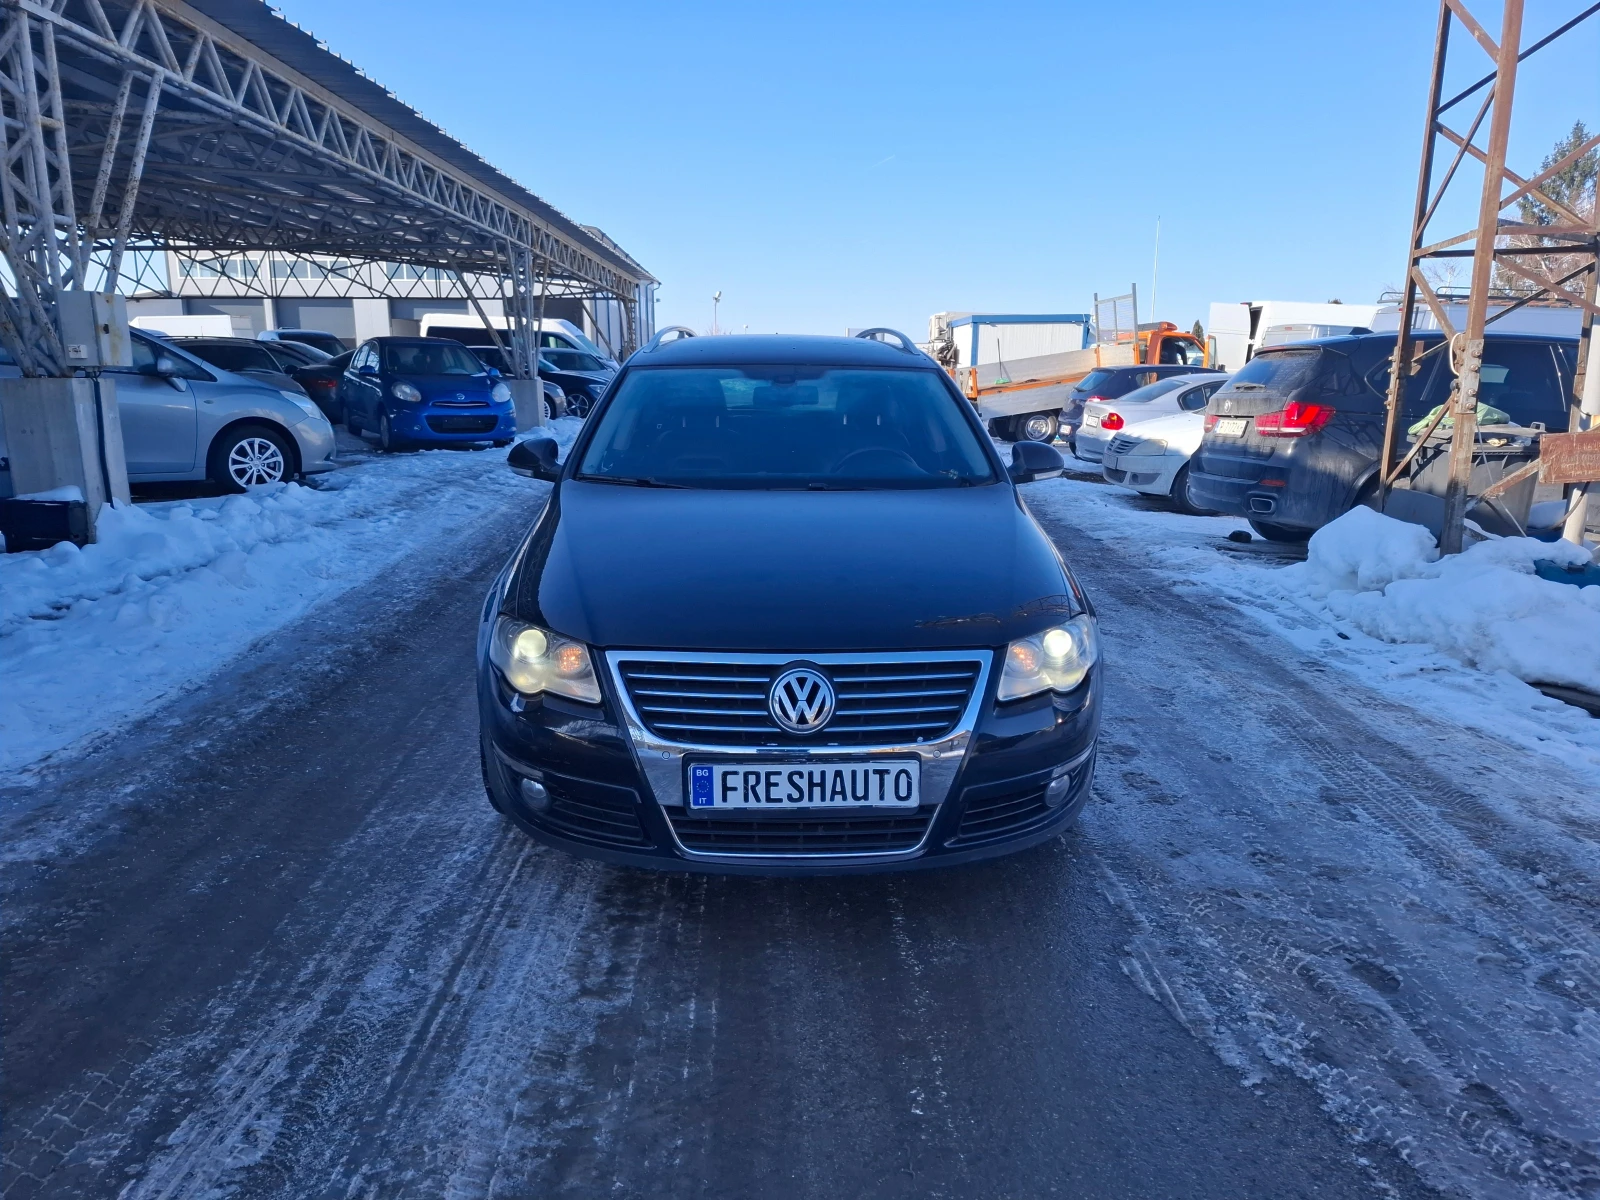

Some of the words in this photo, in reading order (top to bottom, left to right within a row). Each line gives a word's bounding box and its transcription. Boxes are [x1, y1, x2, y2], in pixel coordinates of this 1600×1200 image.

[773, 672, 832, 729] VW
[696, 769, 709, 777] BG
[720, 768, 914, 803] FRESHAUTO
